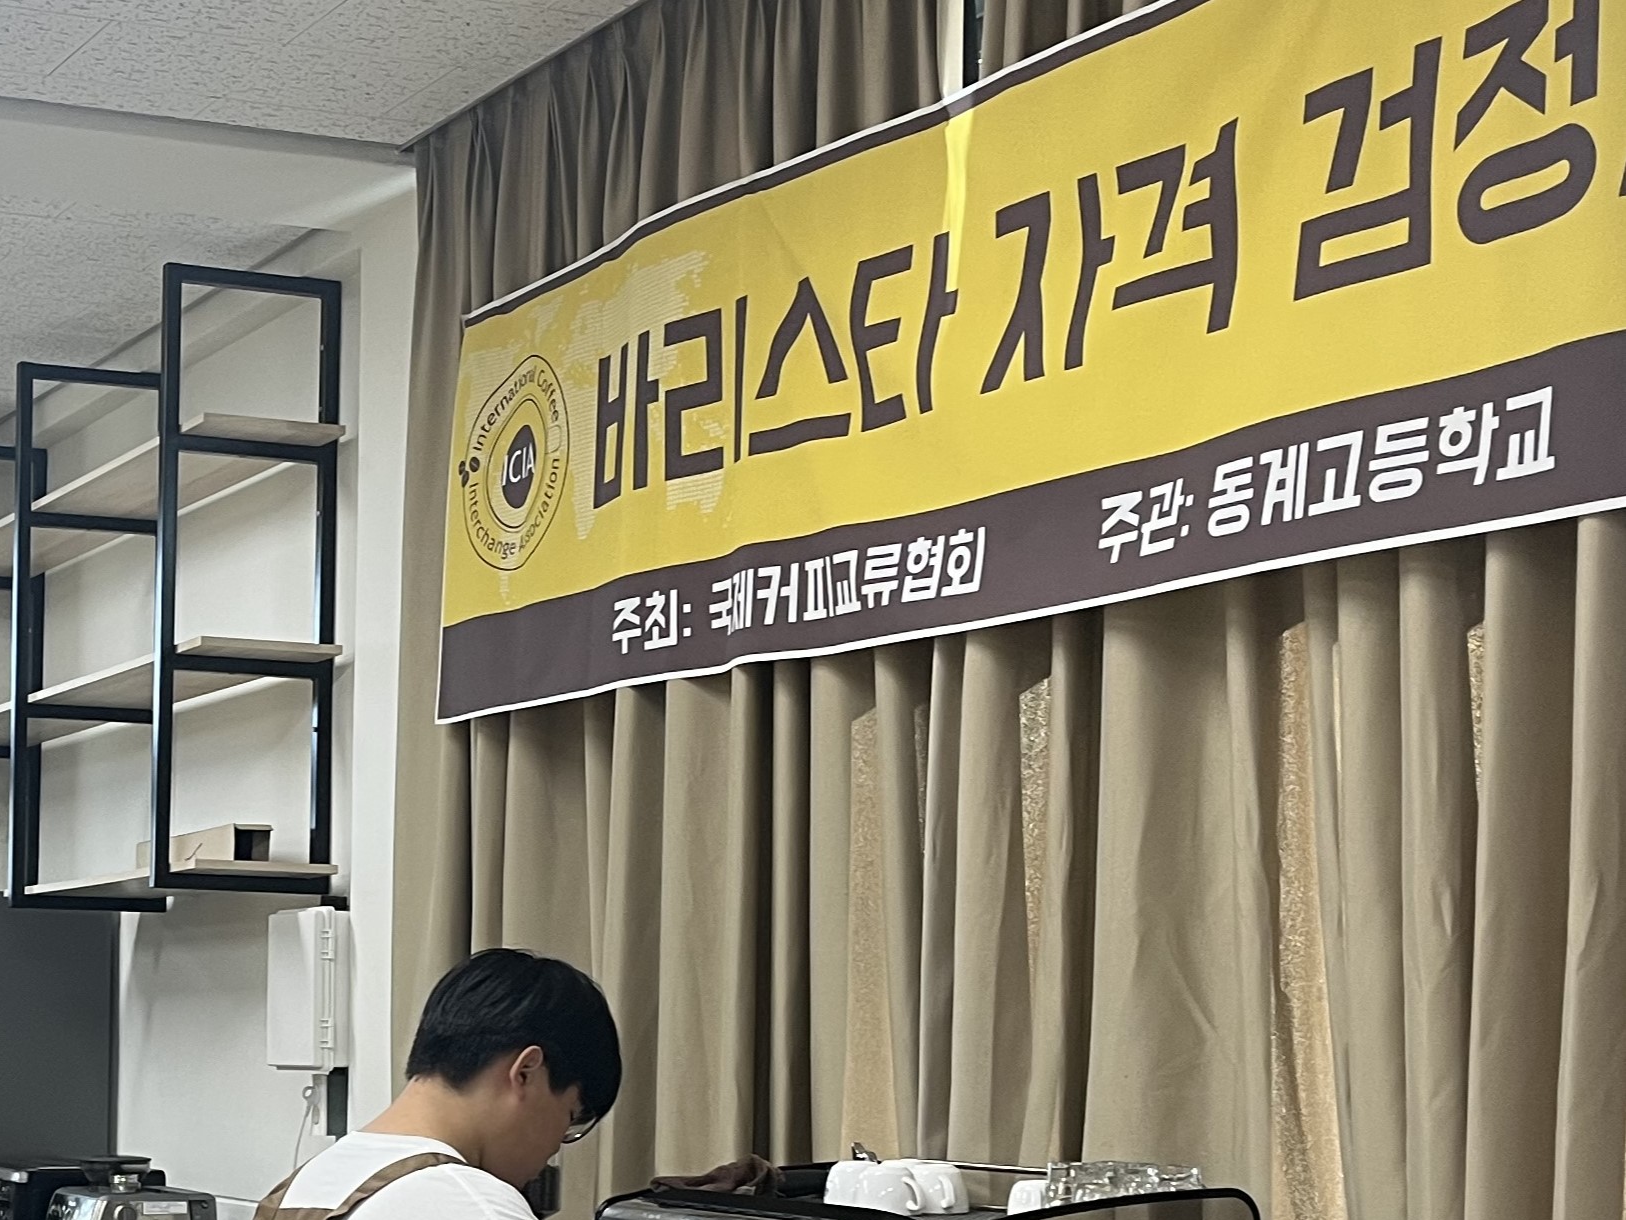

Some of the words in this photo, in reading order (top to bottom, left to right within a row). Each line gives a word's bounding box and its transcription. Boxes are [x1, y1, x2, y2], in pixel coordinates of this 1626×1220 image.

[593, 231, 959, 510] 바리스타
[979, 117, 1239, 395] 자격
[1293, 0, 1626, 302] 검정
[472, 364, 537, 453] International
[536, 368, 560, 424] Coffee
[501, 441, 536, 487] ICIA
[1207, 385, 1556, 538] 동계고등학교
[468, 482, 517, 560] Interchange
[611, 588, 692, 655] 주최:
